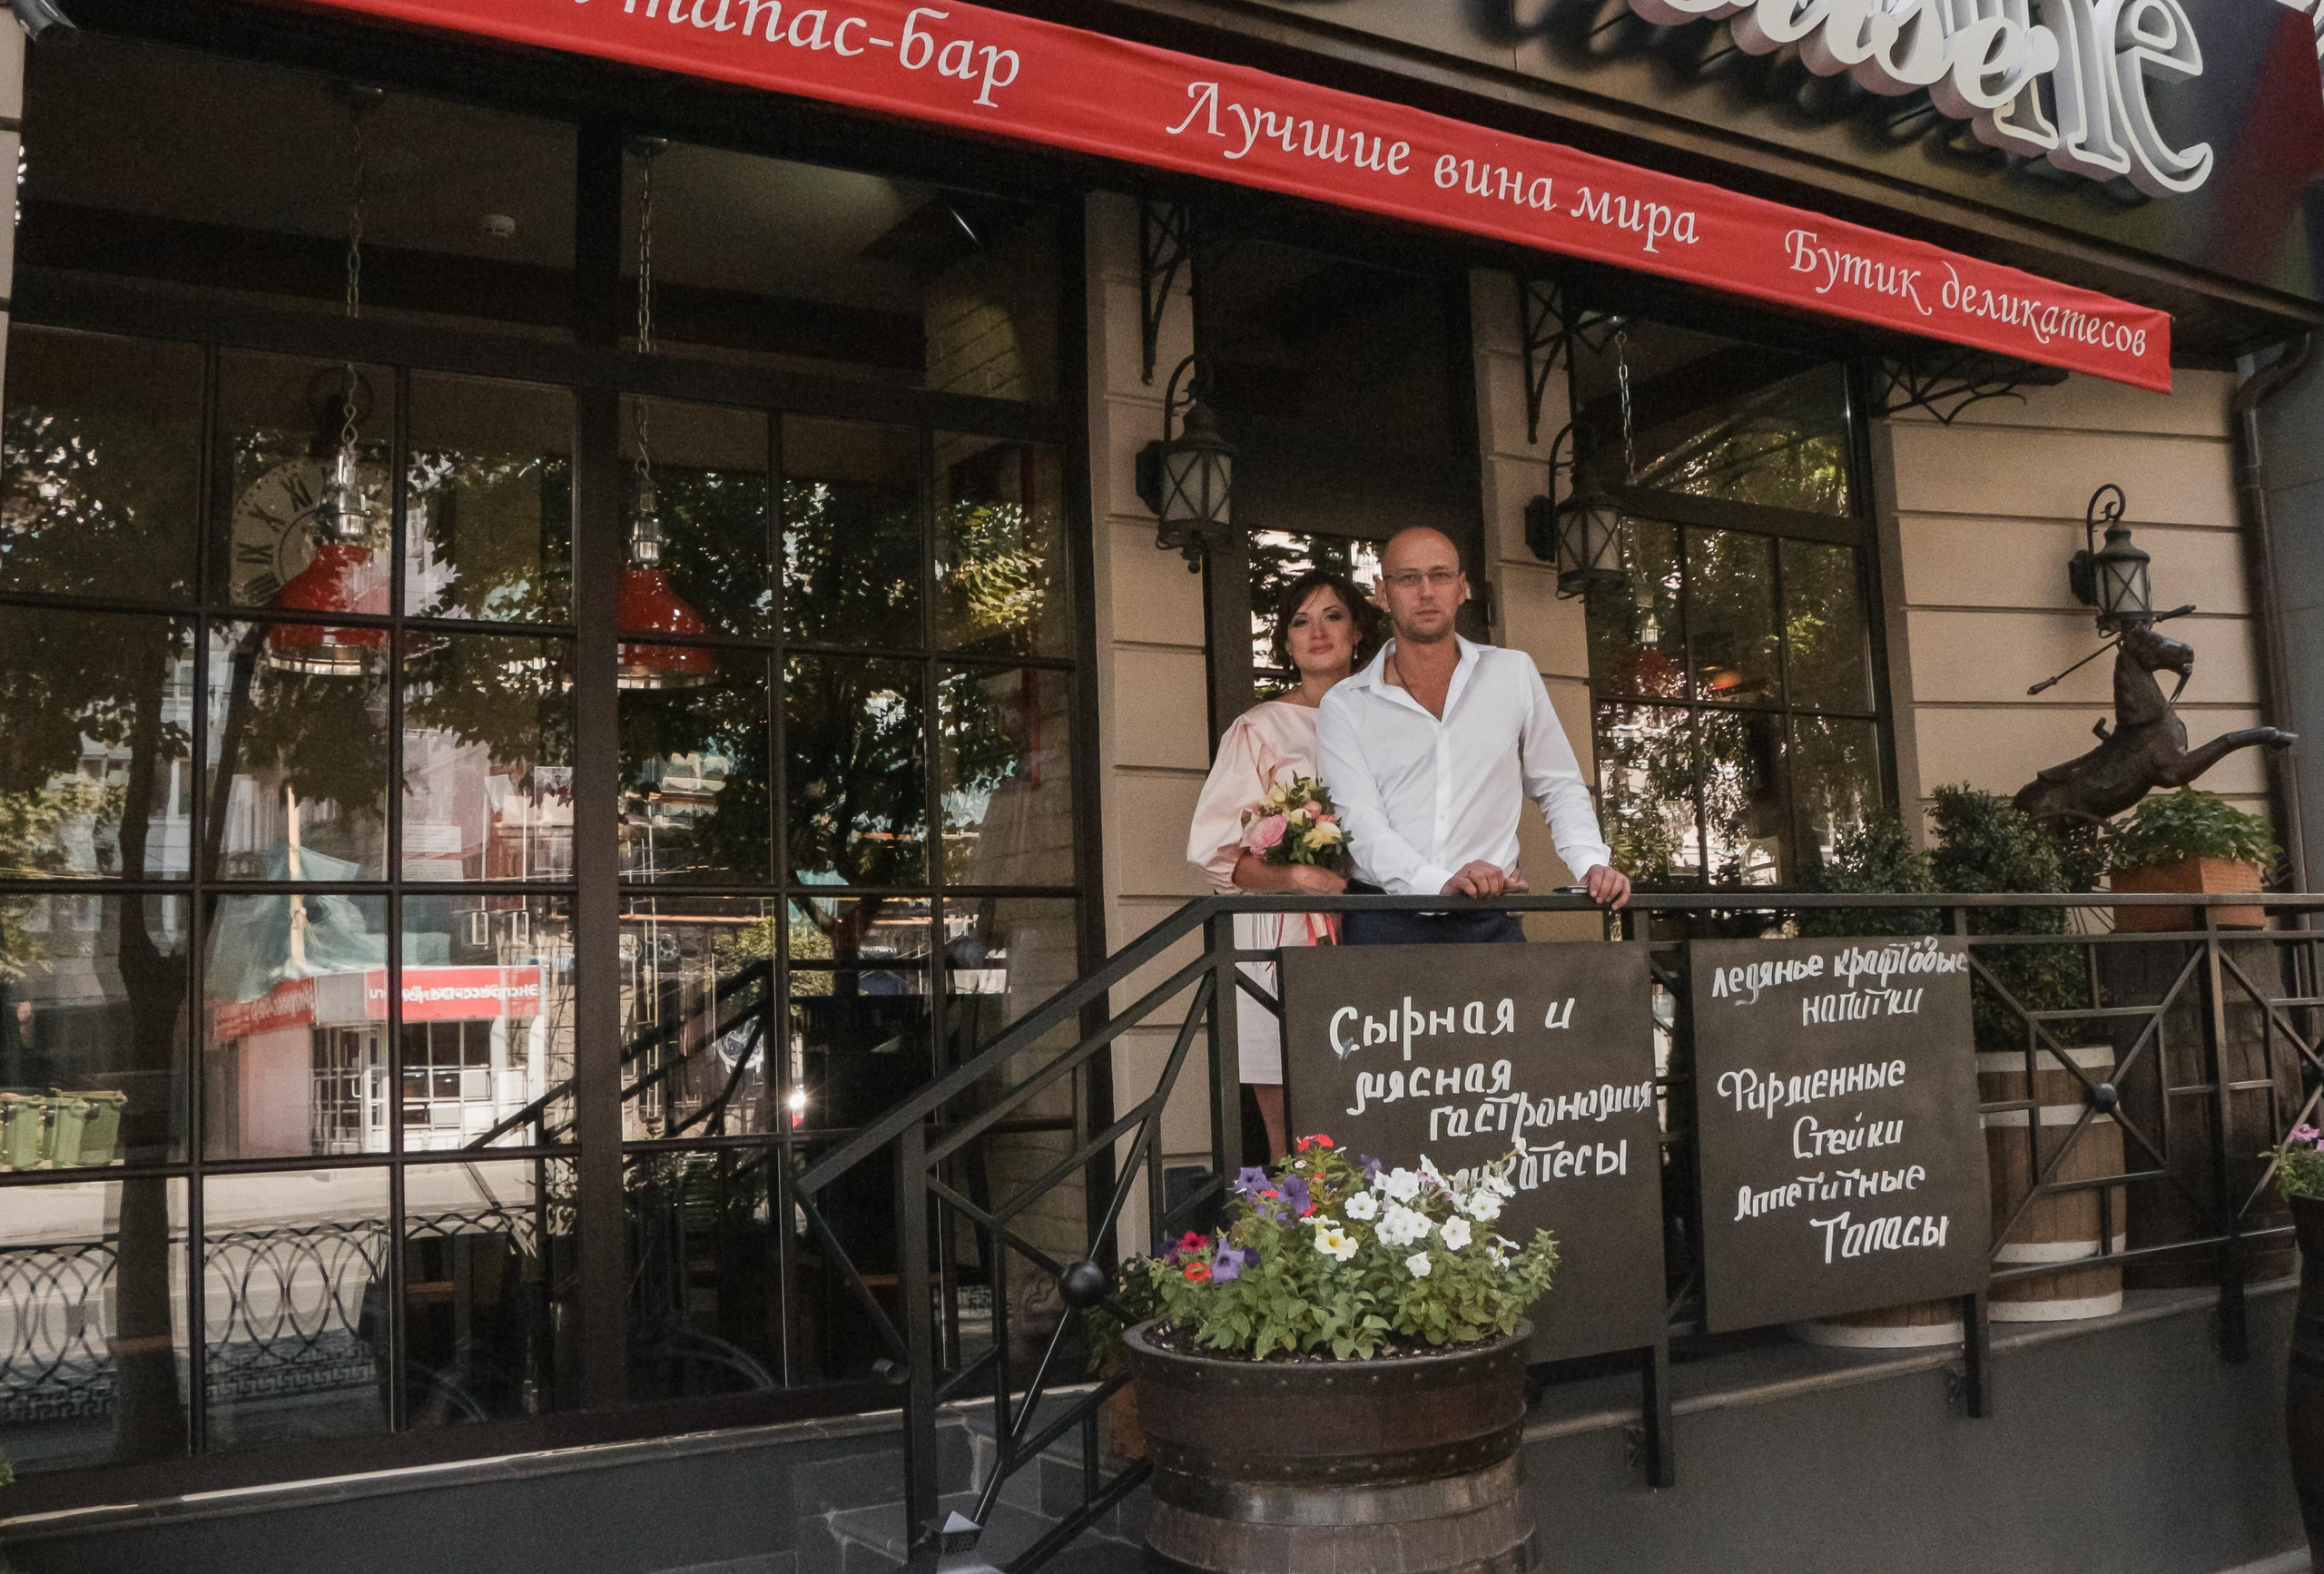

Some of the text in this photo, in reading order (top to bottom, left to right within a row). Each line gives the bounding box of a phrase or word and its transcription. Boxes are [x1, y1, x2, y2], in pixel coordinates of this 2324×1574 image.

[1166, 81, 1699, 253] Лучшие вина мира
[1785, 229, 2147, 357] Бутик деликатесов
[1329, 996, 1576, 1062] Сырная и
[1802, 988, 1924, 1027] напитки
[1345, 1058, 1512, 1116] мясная
[1429, 1080, 1652, 1143] гастрономия
[1717, 1059, 1906, 1119] Фирменные
[1793, 1111, 1904, 1159] Стейки
[1734, 1165, 1926, 1222] Аппетитные
[1809, 1211, 1950, 1264] Тапасы
